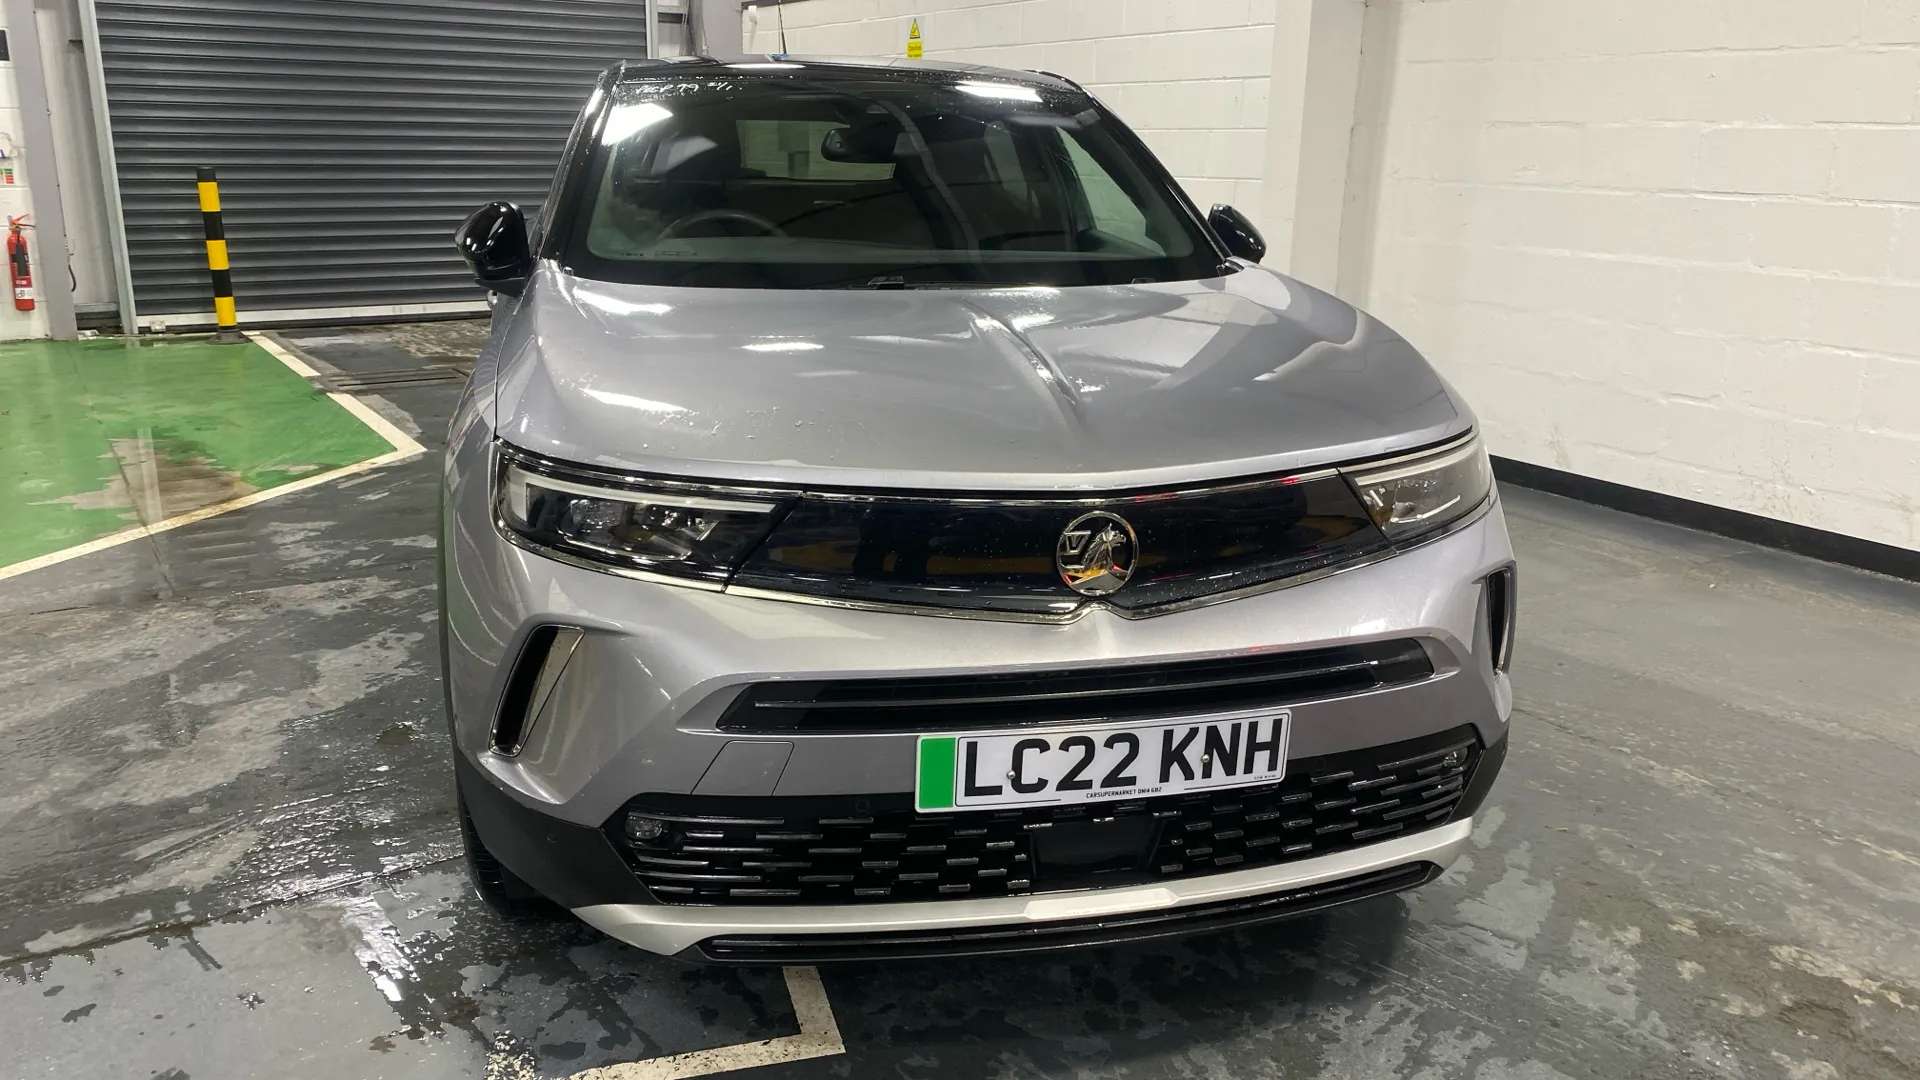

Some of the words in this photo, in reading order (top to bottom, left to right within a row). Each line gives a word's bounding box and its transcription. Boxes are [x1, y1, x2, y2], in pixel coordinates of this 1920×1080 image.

[964, 732, 1140, 796] LC22
[1158, 718, 1283, 784] KNH
[1086, 789, 1136, 798] CARSUPERMARKET
